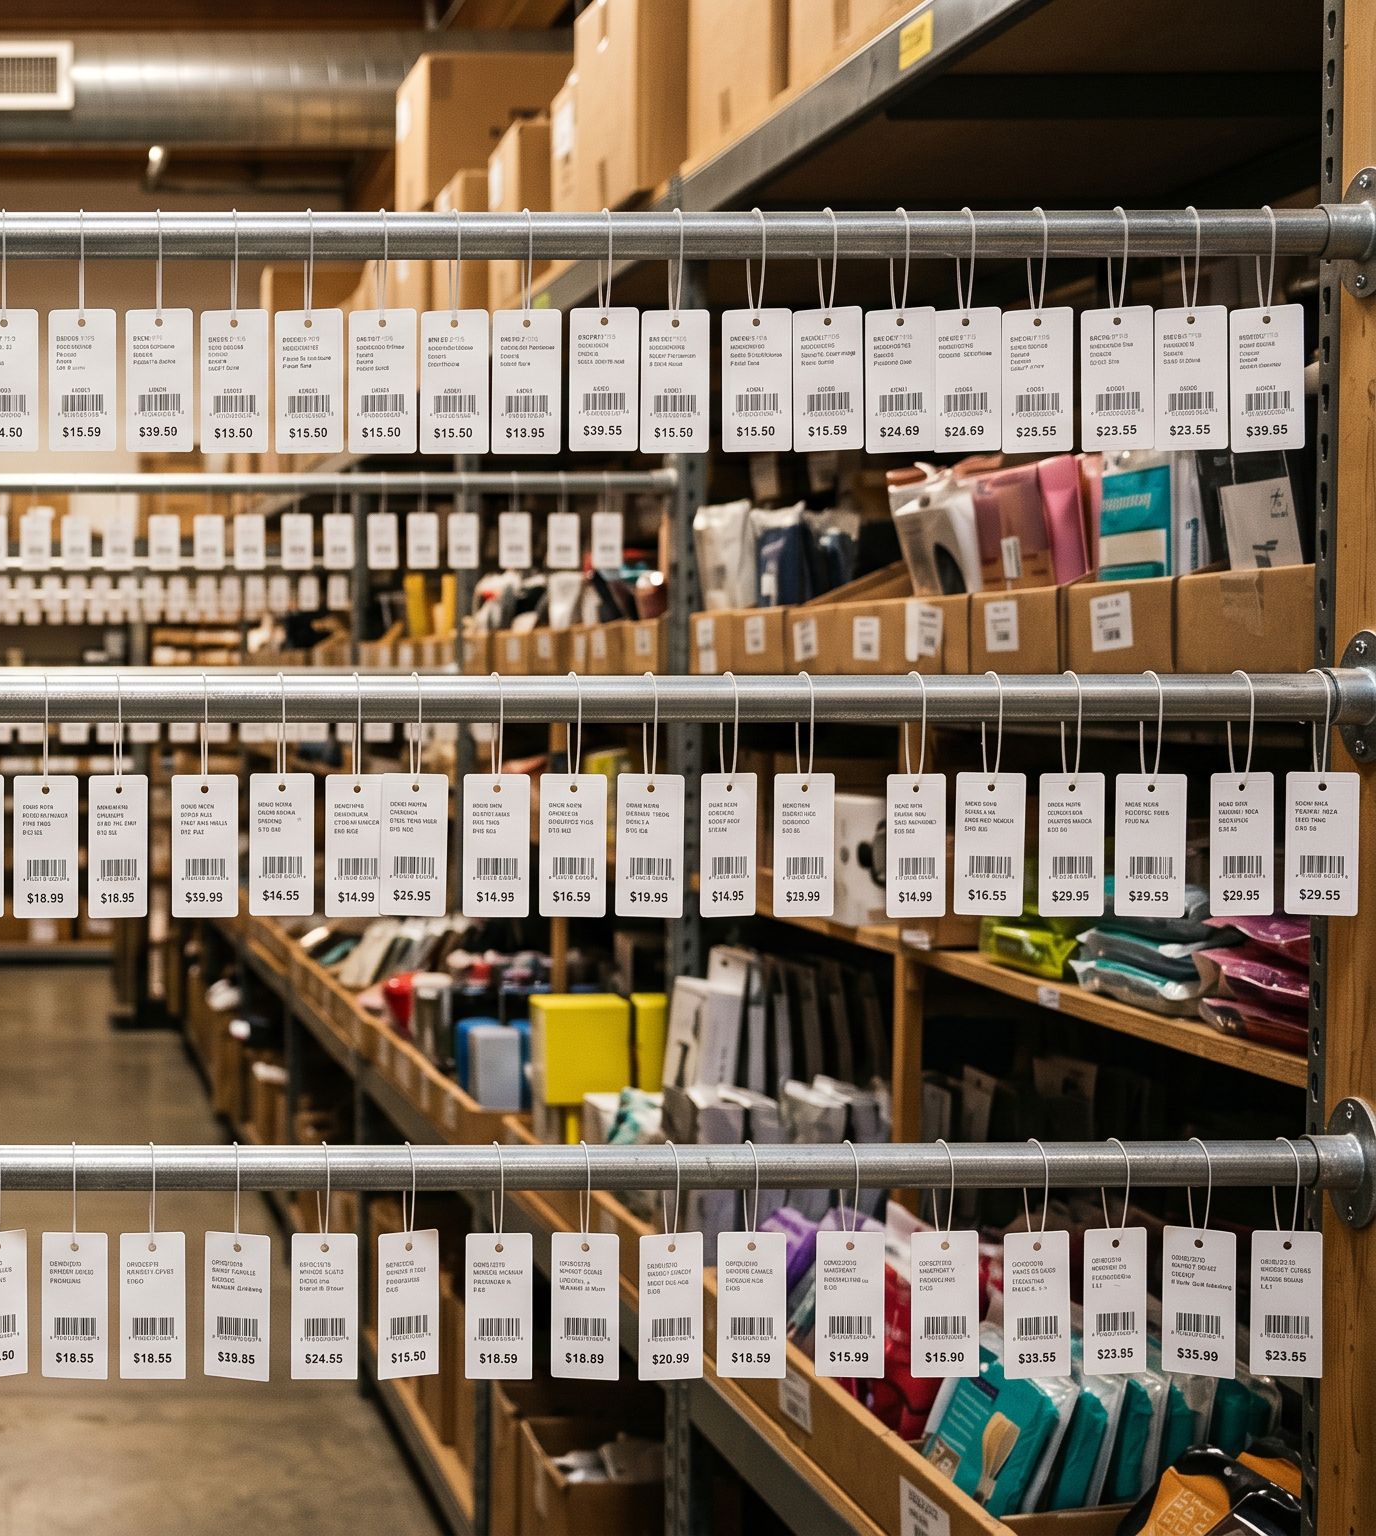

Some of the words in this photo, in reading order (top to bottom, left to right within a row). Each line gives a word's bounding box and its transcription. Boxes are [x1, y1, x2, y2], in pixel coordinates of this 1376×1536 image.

[62, 426, 102, 439] $15.59
[138, 426, 178, 438] $39.50
[288, 427, 328, 440] $15.50
[361, 426, 401, 439] $15.50
[433, 427, 473, 440] $15.50
[583, 424, 623, 437] $39.55
[653, 426, 694, 439] $15.50
[736, 425, 776, 438] $15.50
[807, 424, 848, 438] $15.59
[879, 425, 920, 439] $24.69
[1096, 424, 1138, 438] $23.55
[1169, 424, 1211, 437] $23.55
[100, 892, 135, 905] $18.95
[337, 891, 375, 904] $14.99
[552, 890, 591, 903] $16.59
[711, 890, 745, 904] $14.95
[898, 890, 933, 904] $14.99
[967, 888, 1007, 902] $16.55
[1222, 889, 1260, 902] $29.95
[1298, 888, 1341, 901] $29.55
[55, 1351, 94, 1364] $18.55
[133, 1352, 173, 1364] $18.55
[304, 1353, 343, 1365] $24.55
[391, 1350, 427, 1365] $15.50
[479, 1352, 518, 1365] $18.59
[565, 1352, 605, 1365] $18.89
[651, 1352, 690, 1366] $20.99
[731, 1351, 771, 1364] $18.59
[829, 1350, 869, 1363] $15.99
[924, 1351, 965, 1364] $15.90
[1018, 1351, 1057, 1365] $33.55
[1176, 1347, 1219, 1362] $35.99
[1264, 1349, 1307, 1363] $23.55
